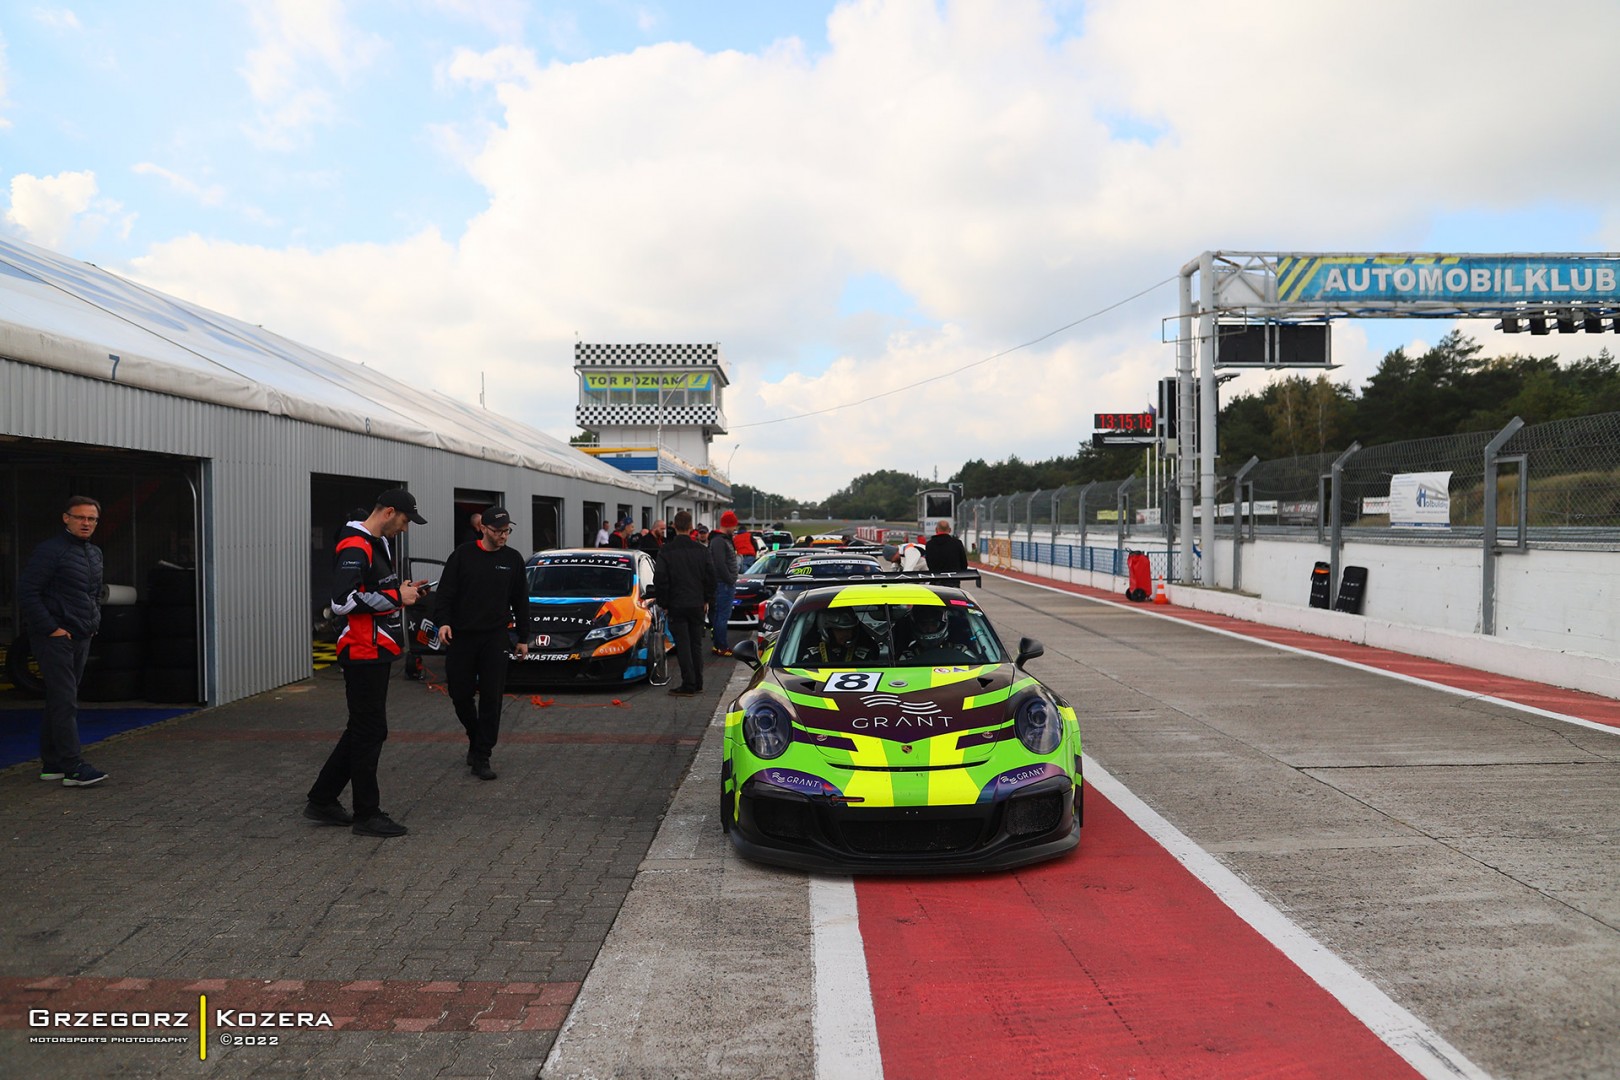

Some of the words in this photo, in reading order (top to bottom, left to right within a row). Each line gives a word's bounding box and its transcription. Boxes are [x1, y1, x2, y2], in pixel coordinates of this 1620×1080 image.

[1324, 267, 1616, 292] AUTOMOBILKLUB
[109, 353, 120, 380] 7
[589, 376, 618, 386] TOR
[365, 416, 371, 434] 6
[1100, 414, 1153, 429] 13:15:18
[848, 572, 957, 580] GRANT
[529, 616, 592, 625] OMPUTEX
[834, 673, 870, 690] 8
[852, 716, 953, 729] GRANT
[1016, 767, 1045, 780] GRANT
[786, 775, 819, 788] GRANT
